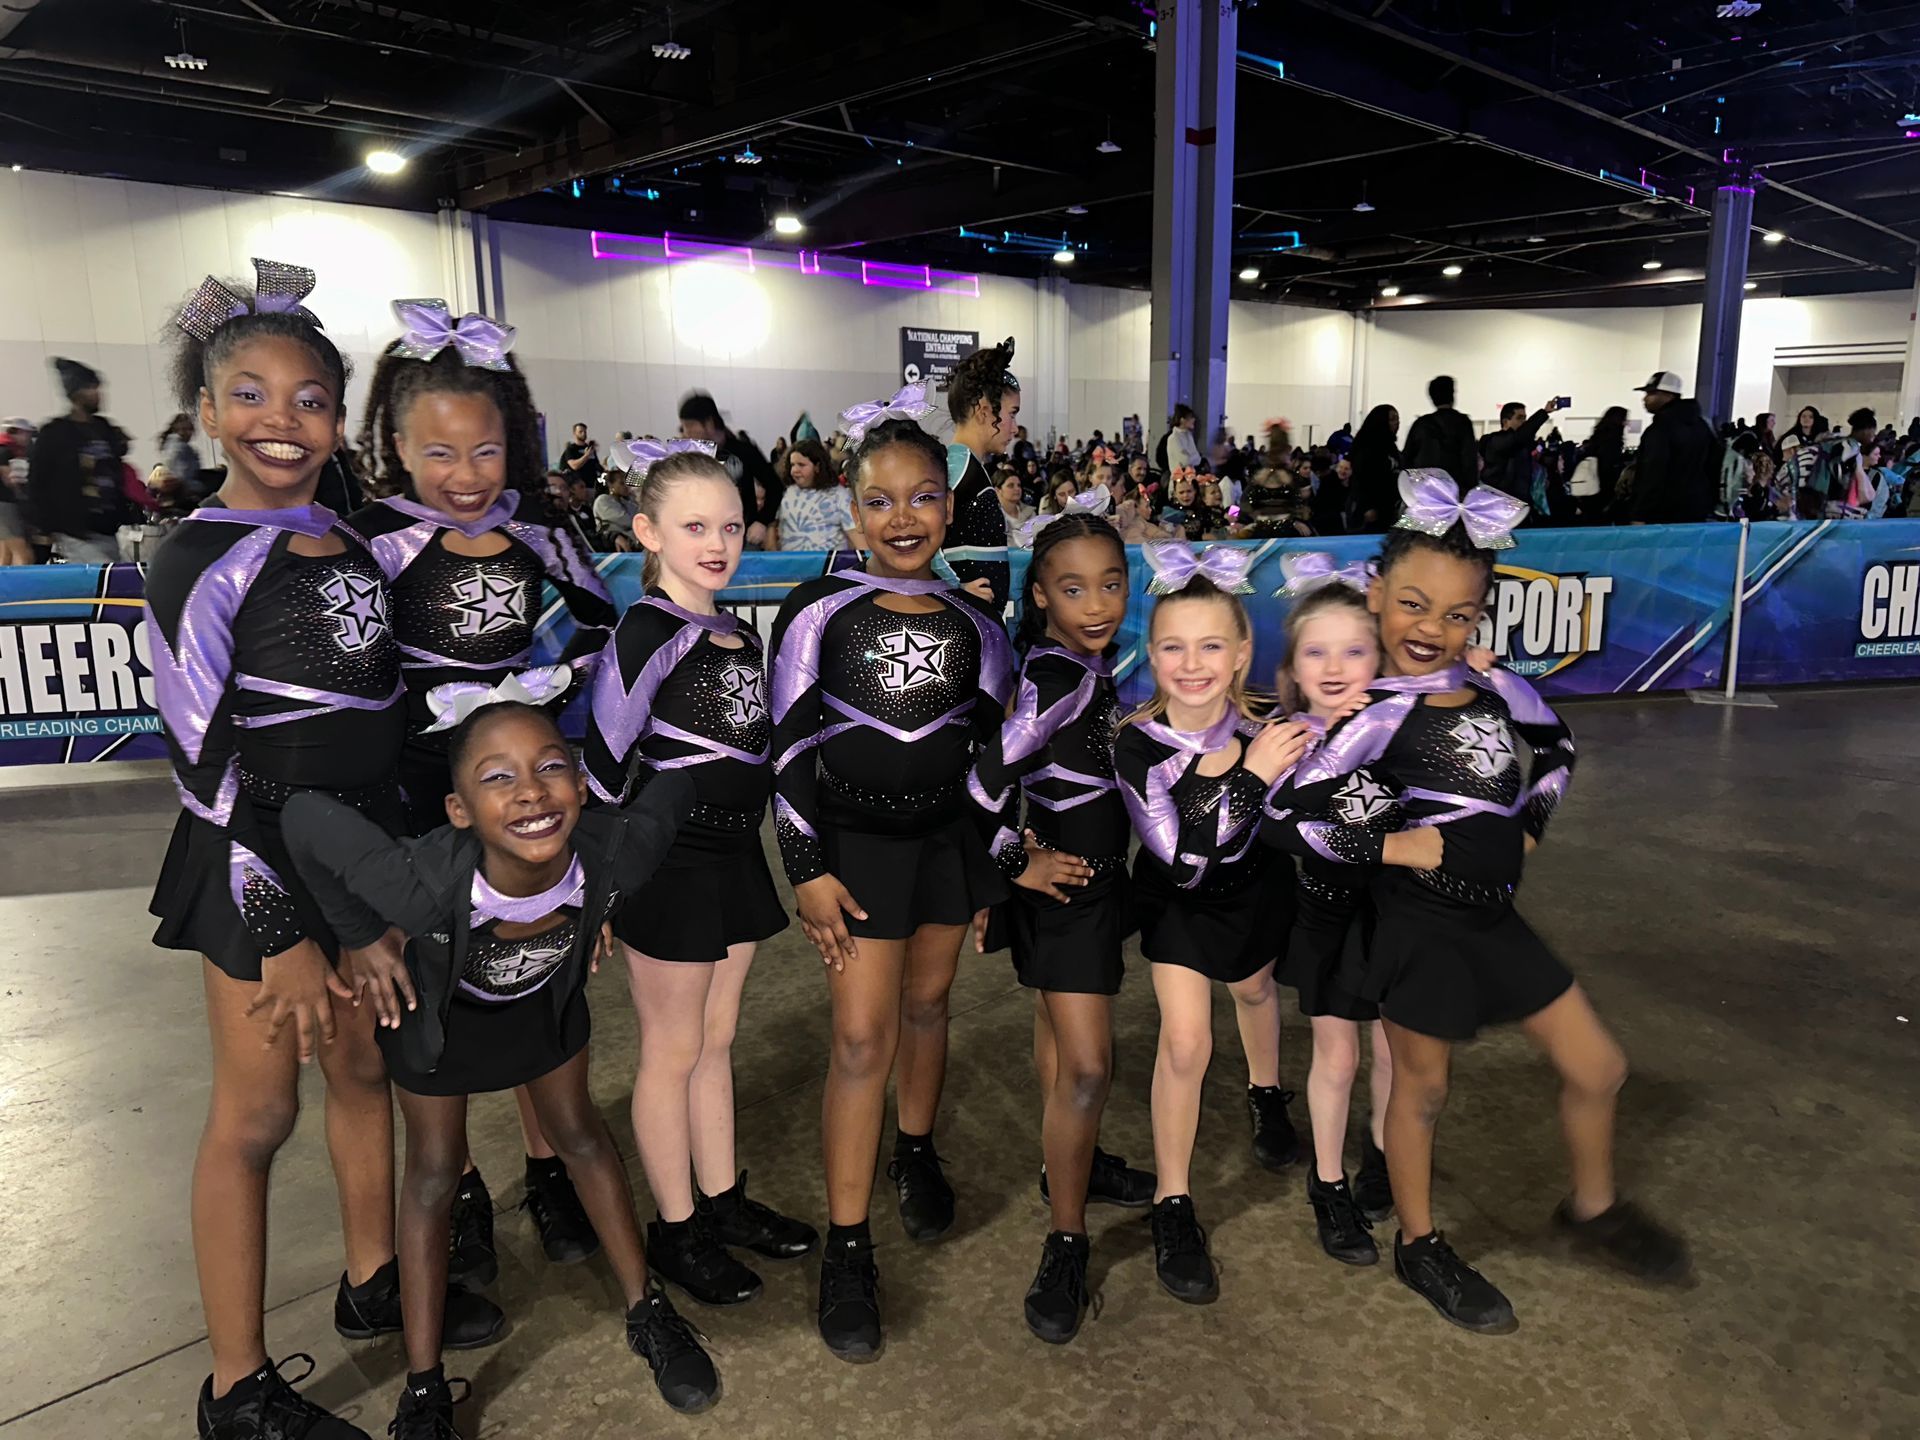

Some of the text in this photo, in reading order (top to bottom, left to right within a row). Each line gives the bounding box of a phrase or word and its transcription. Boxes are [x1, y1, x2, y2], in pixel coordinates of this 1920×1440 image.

[907, 330, 973, 345] NATIONAL CHAMPIONS
[925, 343, 957, 353] ENTRANCE
[1861, 565, 1920, 639] CH
[1503, 661, 1548, 674] SHIPS
[104, 718, 163, 732] CHAM
